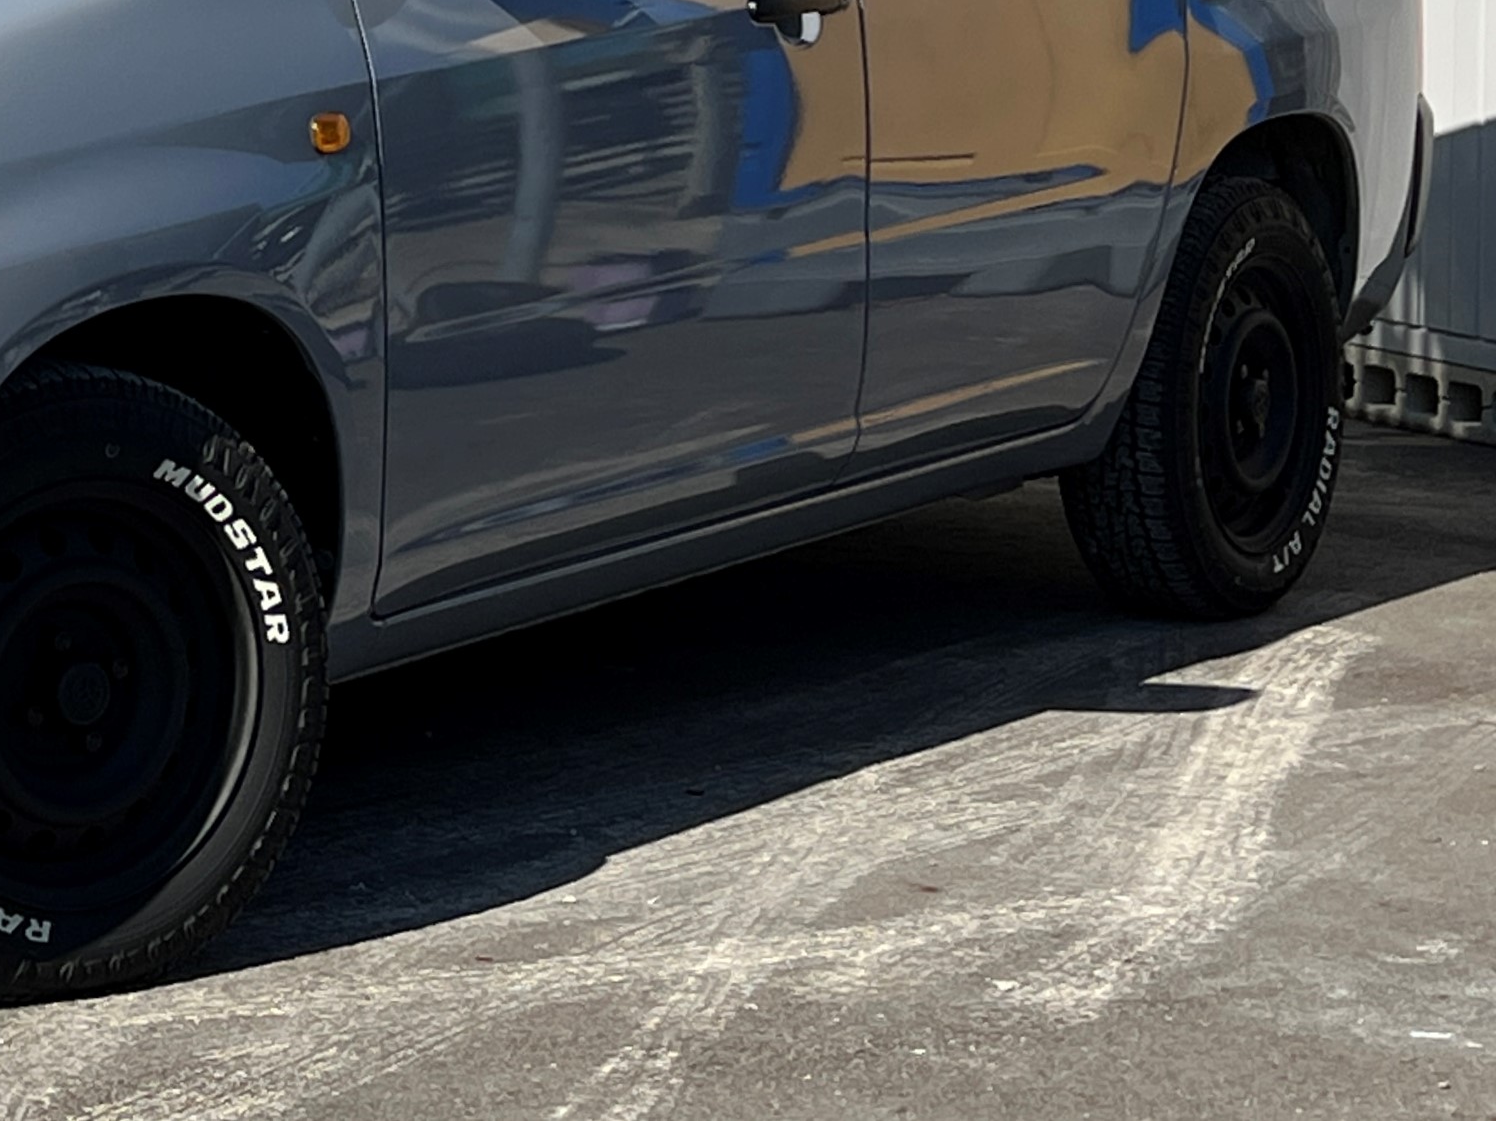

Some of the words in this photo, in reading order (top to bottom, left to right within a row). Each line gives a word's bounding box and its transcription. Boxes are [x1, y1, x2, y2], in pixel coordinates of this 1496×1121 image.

[1301, 406, 1341, 526] RADIAL
[153, 458, 291, 644] MUDSTAR
[1272, 530, 1303, 574] A/T
